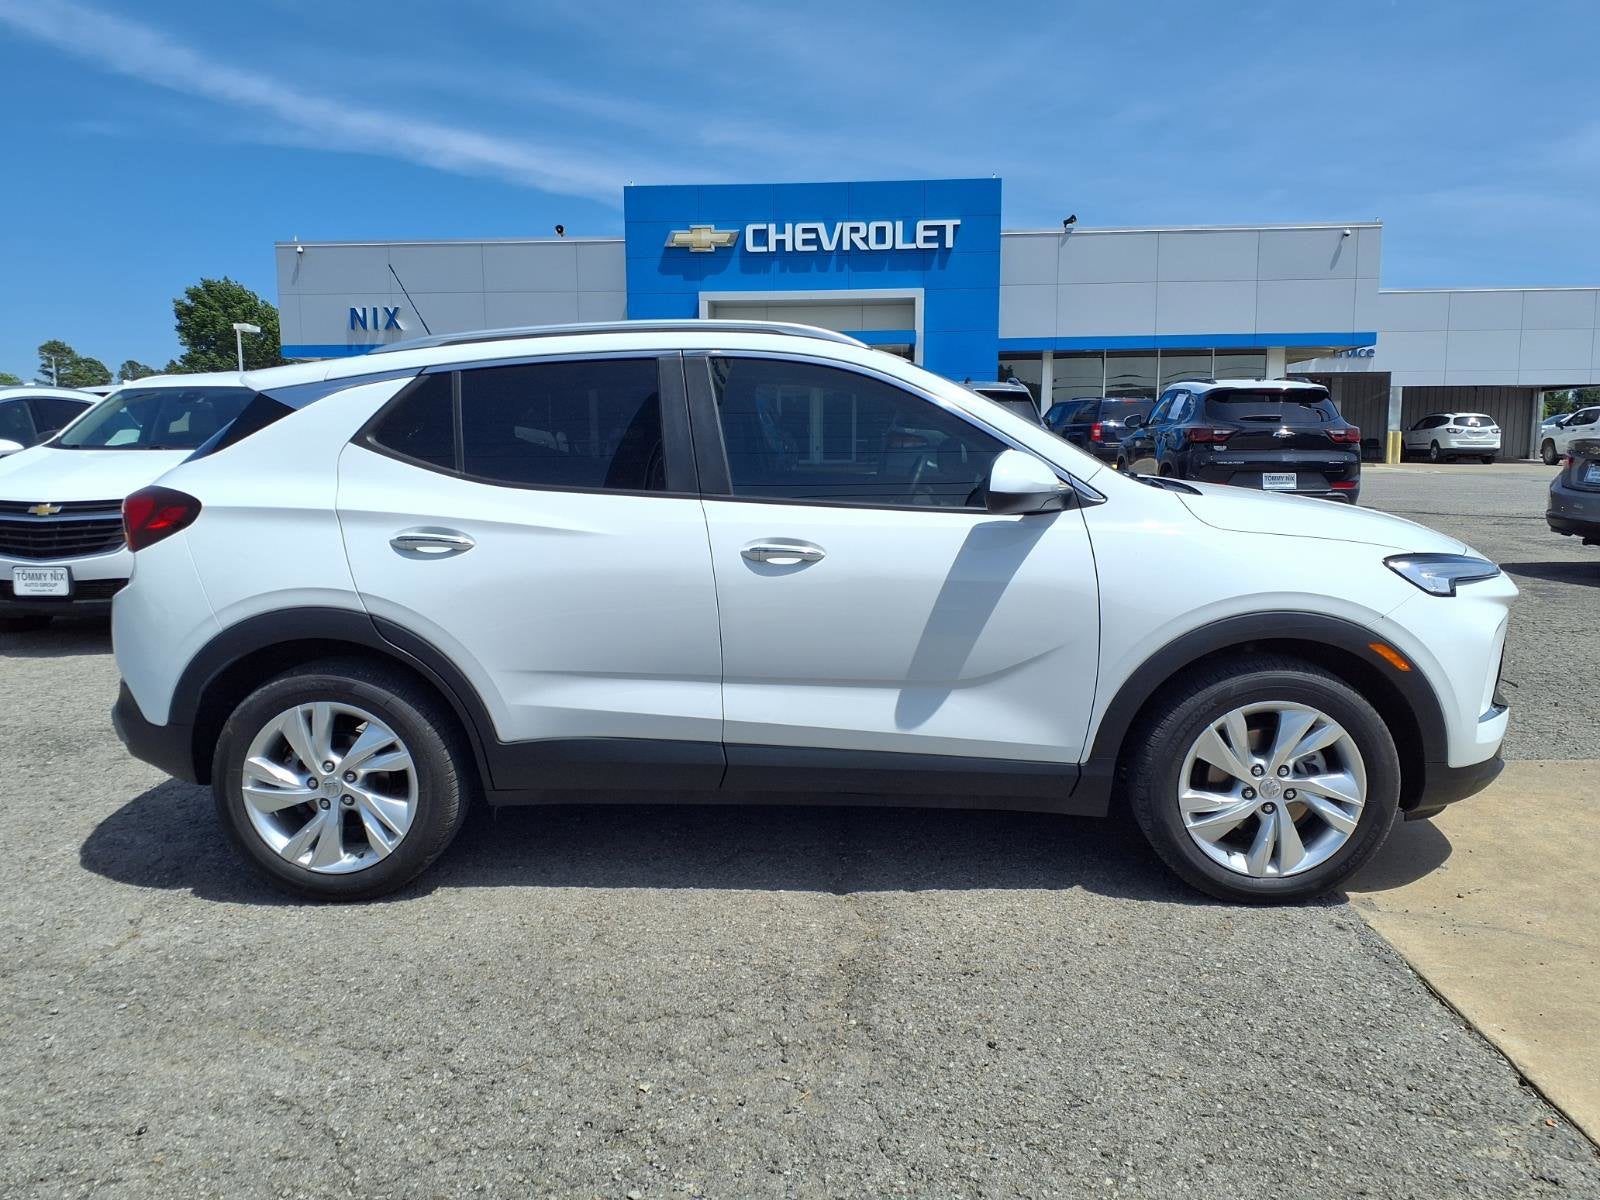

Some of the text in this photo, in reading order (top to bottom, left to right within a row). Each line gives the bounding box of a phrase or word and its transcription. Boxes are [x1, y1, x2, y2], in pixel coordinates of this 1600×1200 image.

[745, 219, 961, 252] CHEVROLET
[350, 306, 402, 330] NIX
[16, 572, 65, 581] TOMMY NIX
